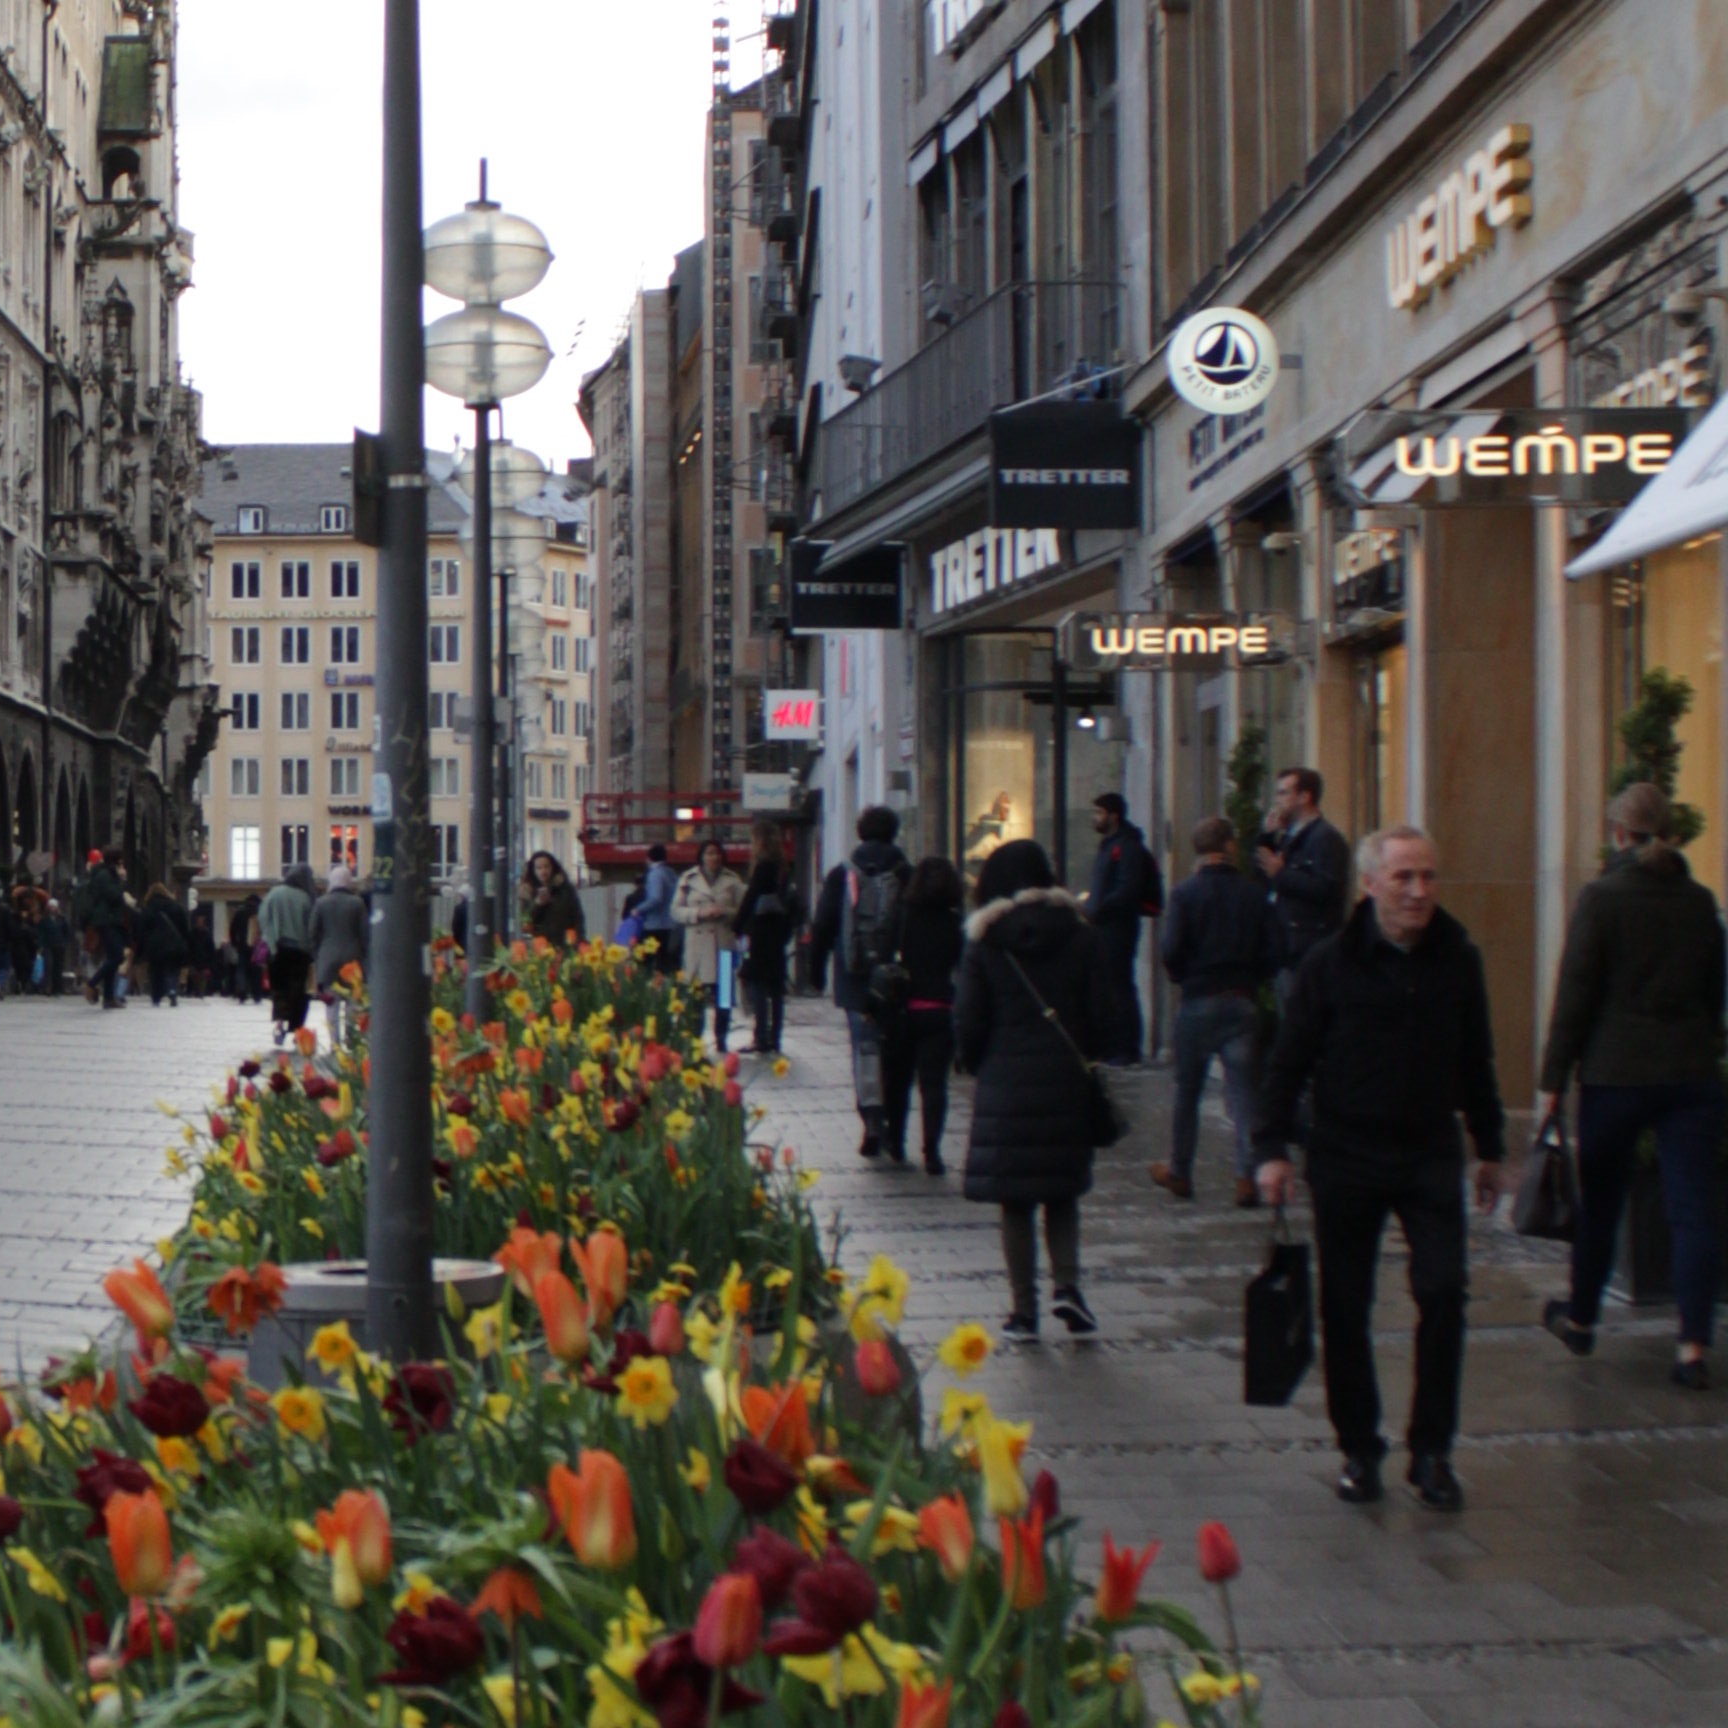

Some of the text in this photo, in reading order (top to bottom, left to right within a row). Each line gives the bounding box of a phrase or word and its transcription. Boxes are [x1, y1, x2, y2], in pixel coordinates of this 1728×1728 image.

[1386, 124, 1530, 309] WEMPE
[1395, 433, 1673, 476] WEMPE
[999, 468, 1130, 485] TRETTER
[797, 582, 897, 596] TRETTER
[1090, 626, 1269, 655] WEMPE
[773, 699, 816, 729] H&M
